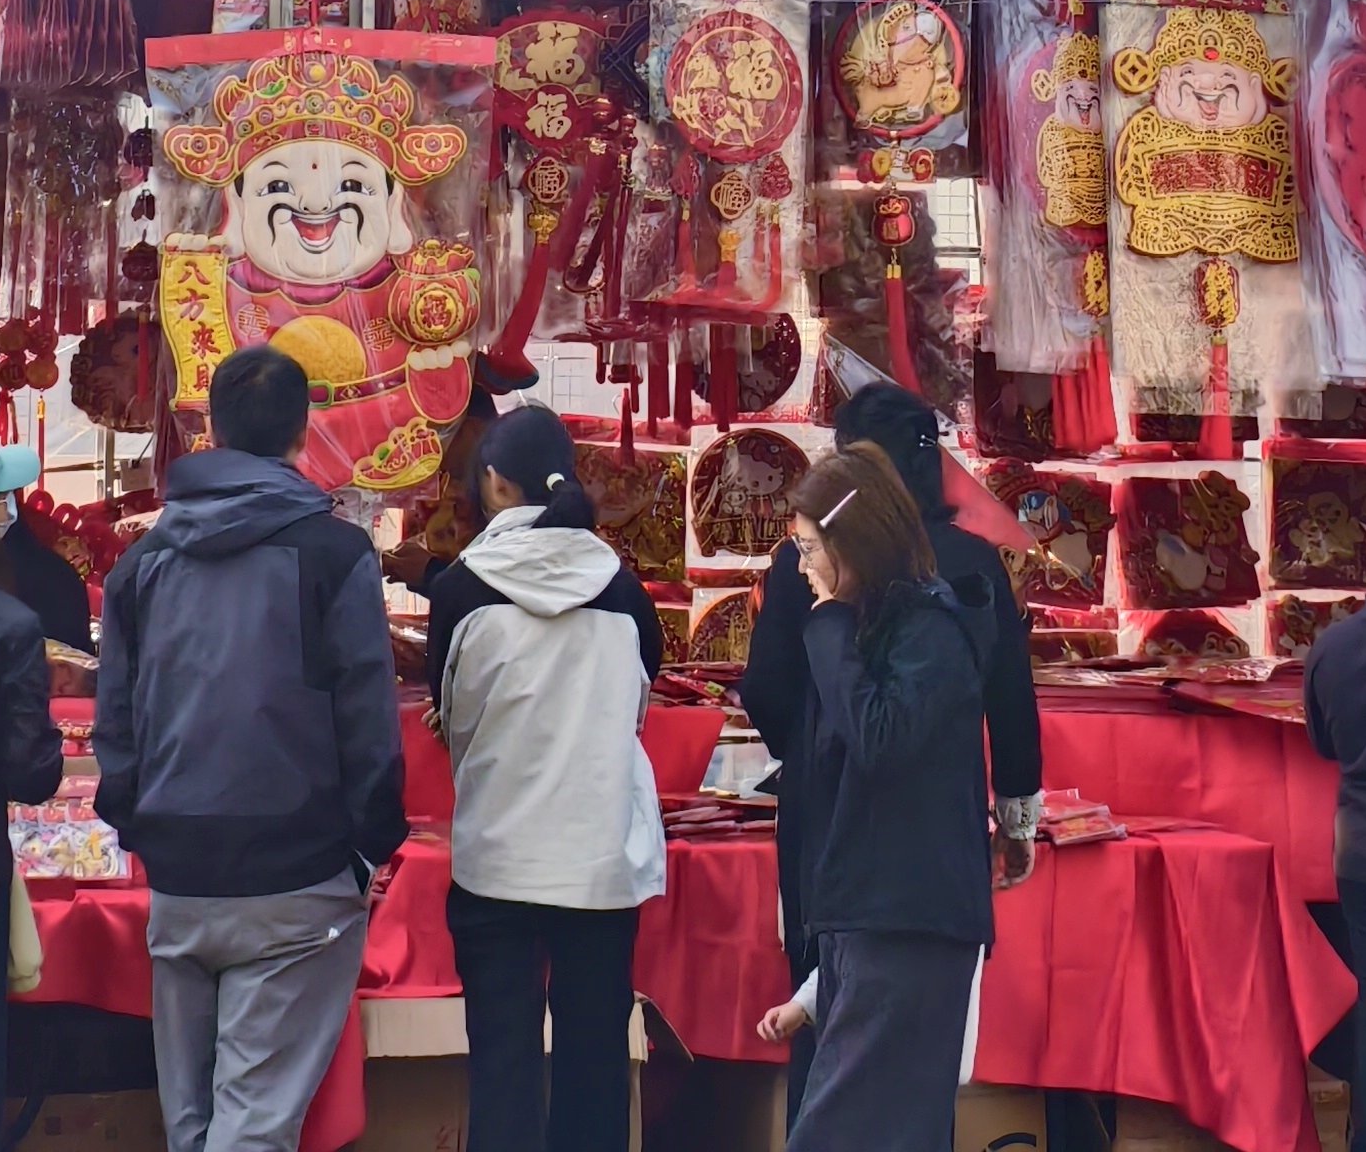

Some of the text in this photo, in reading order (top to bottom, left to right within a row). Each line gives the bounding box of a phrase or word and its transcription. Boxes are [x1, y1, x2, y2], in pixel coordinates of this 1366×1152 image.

[524, 22, 586, 85] 福
[725, 37, 784, 101] 福
[524, 91, 573, 140] 福
